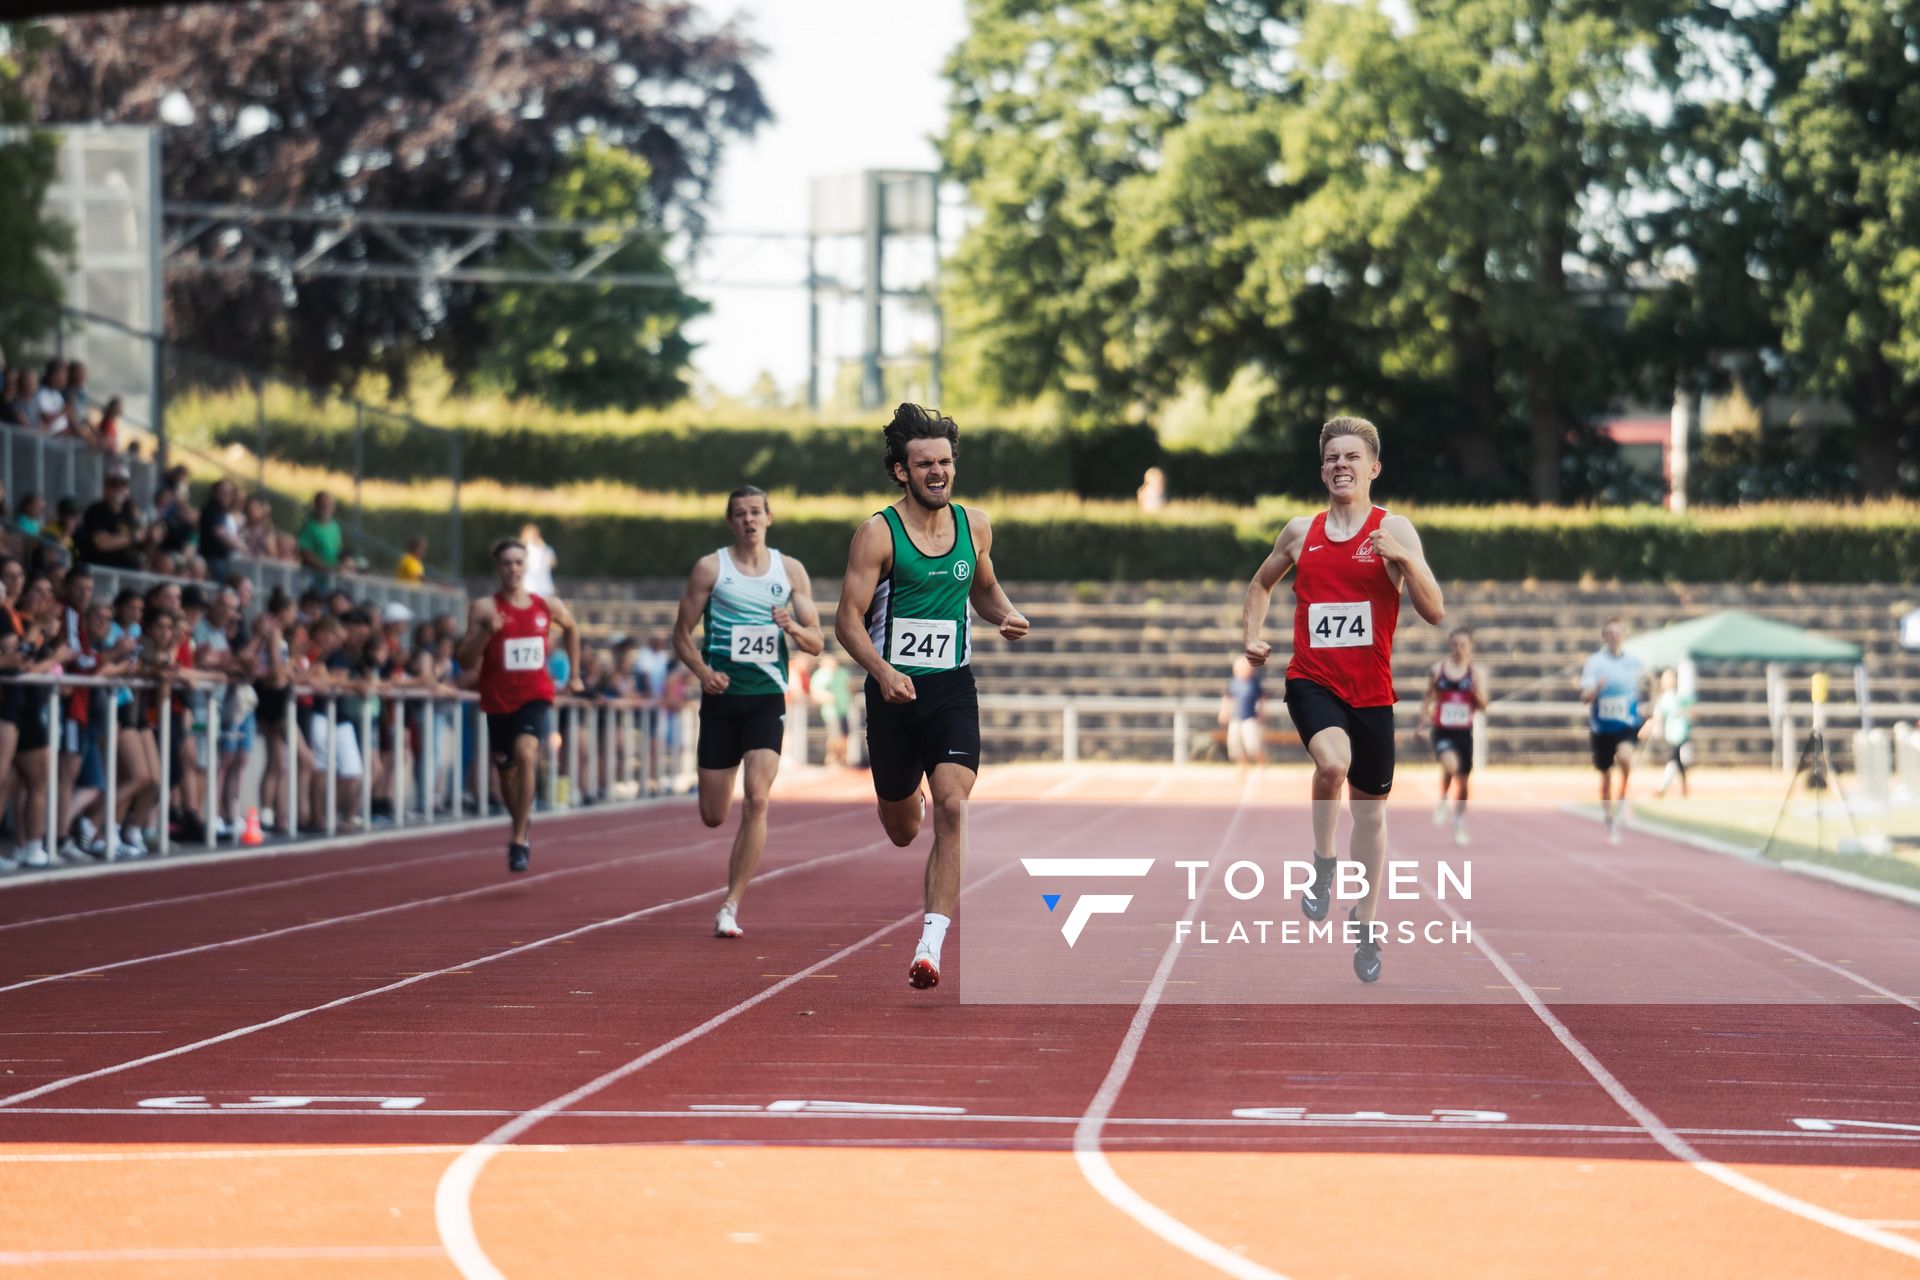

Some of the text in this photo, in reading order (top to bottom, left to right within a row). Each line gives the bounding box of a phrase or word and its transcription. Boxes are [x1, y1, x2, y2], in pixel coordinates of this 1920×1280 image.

[1315, 615, 1365, 638] 474
[738, 636, 775, 655] 245
[899, 632, 950, 658] 247
